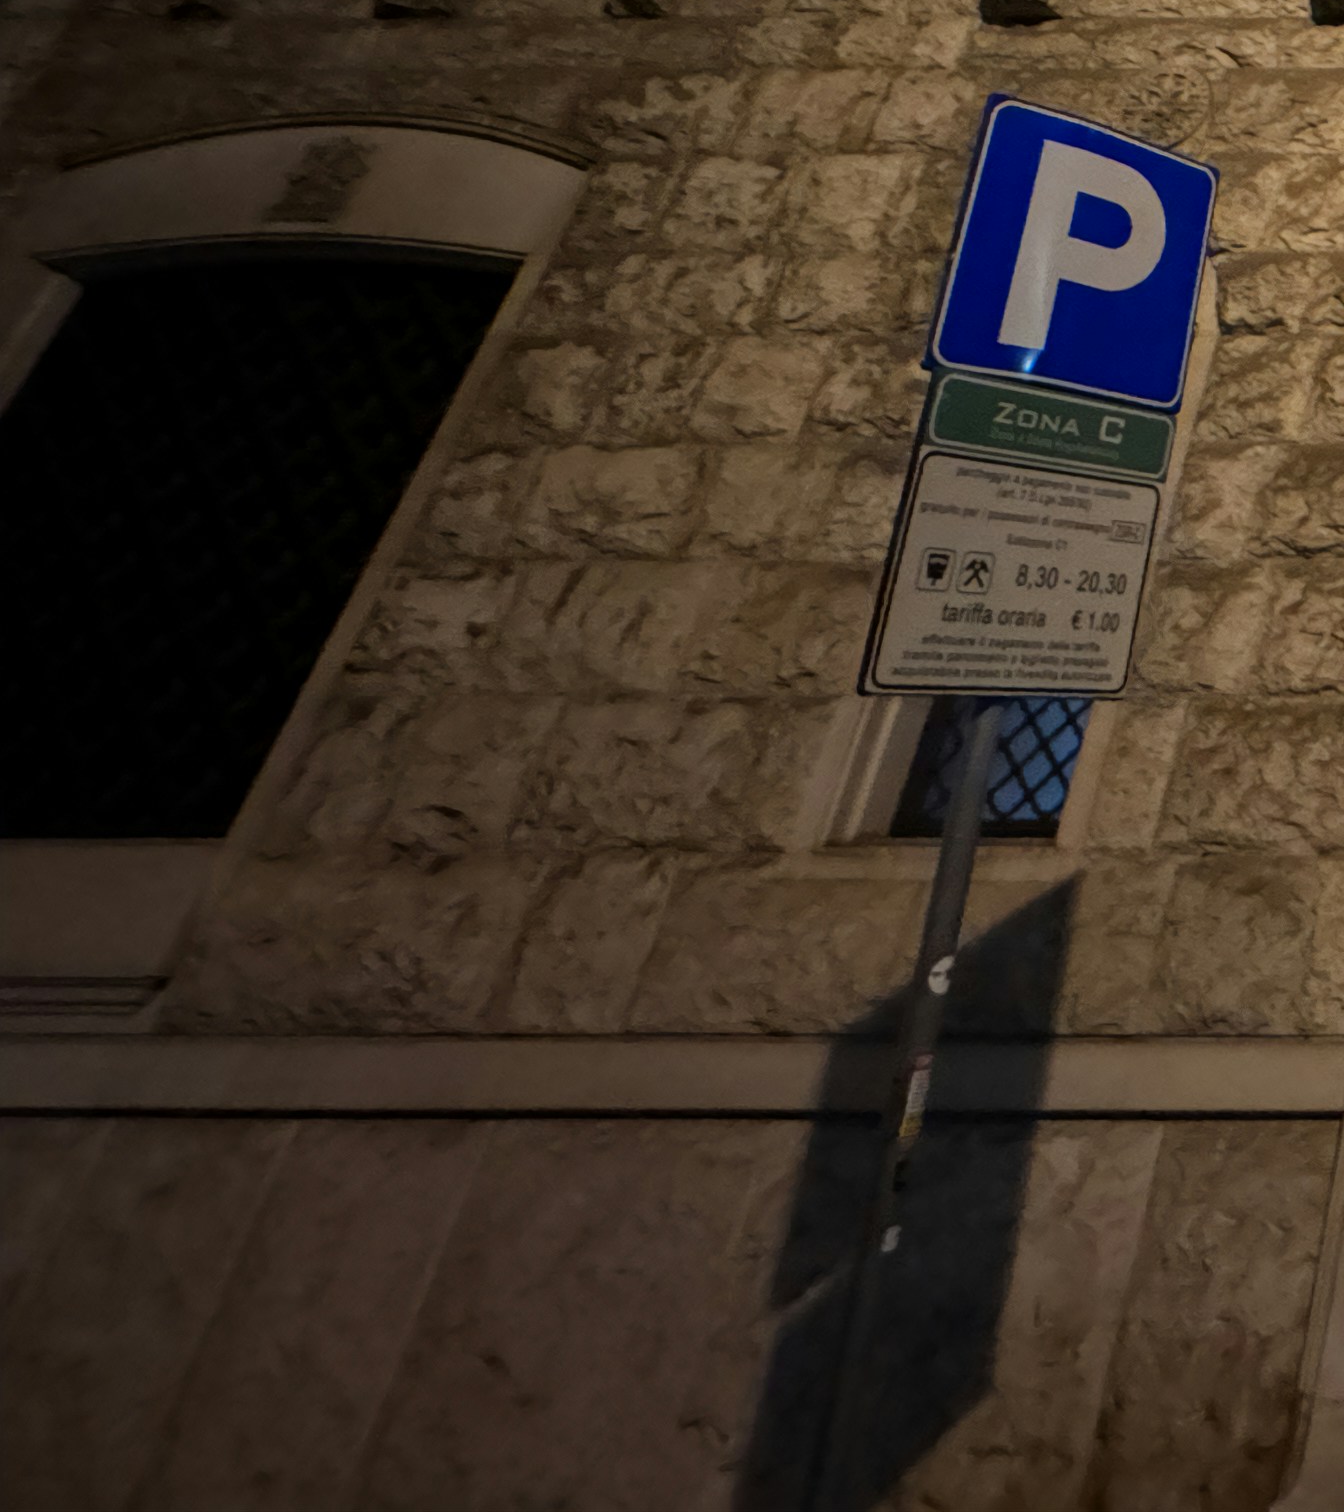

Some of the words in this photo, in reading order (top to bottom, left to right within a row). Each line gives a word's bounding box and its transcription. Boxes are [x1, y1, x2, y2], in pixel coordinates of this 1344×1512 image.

[998, 139, 1167, 349] P
[1099, 416, 1126, 445] C
[1015, 564, 1059, 590] 8,30
[942, 603, 993, 625] tariffa
[998, 609, 1047, 627] oraria
[1071, 610, 1083, 630] €
